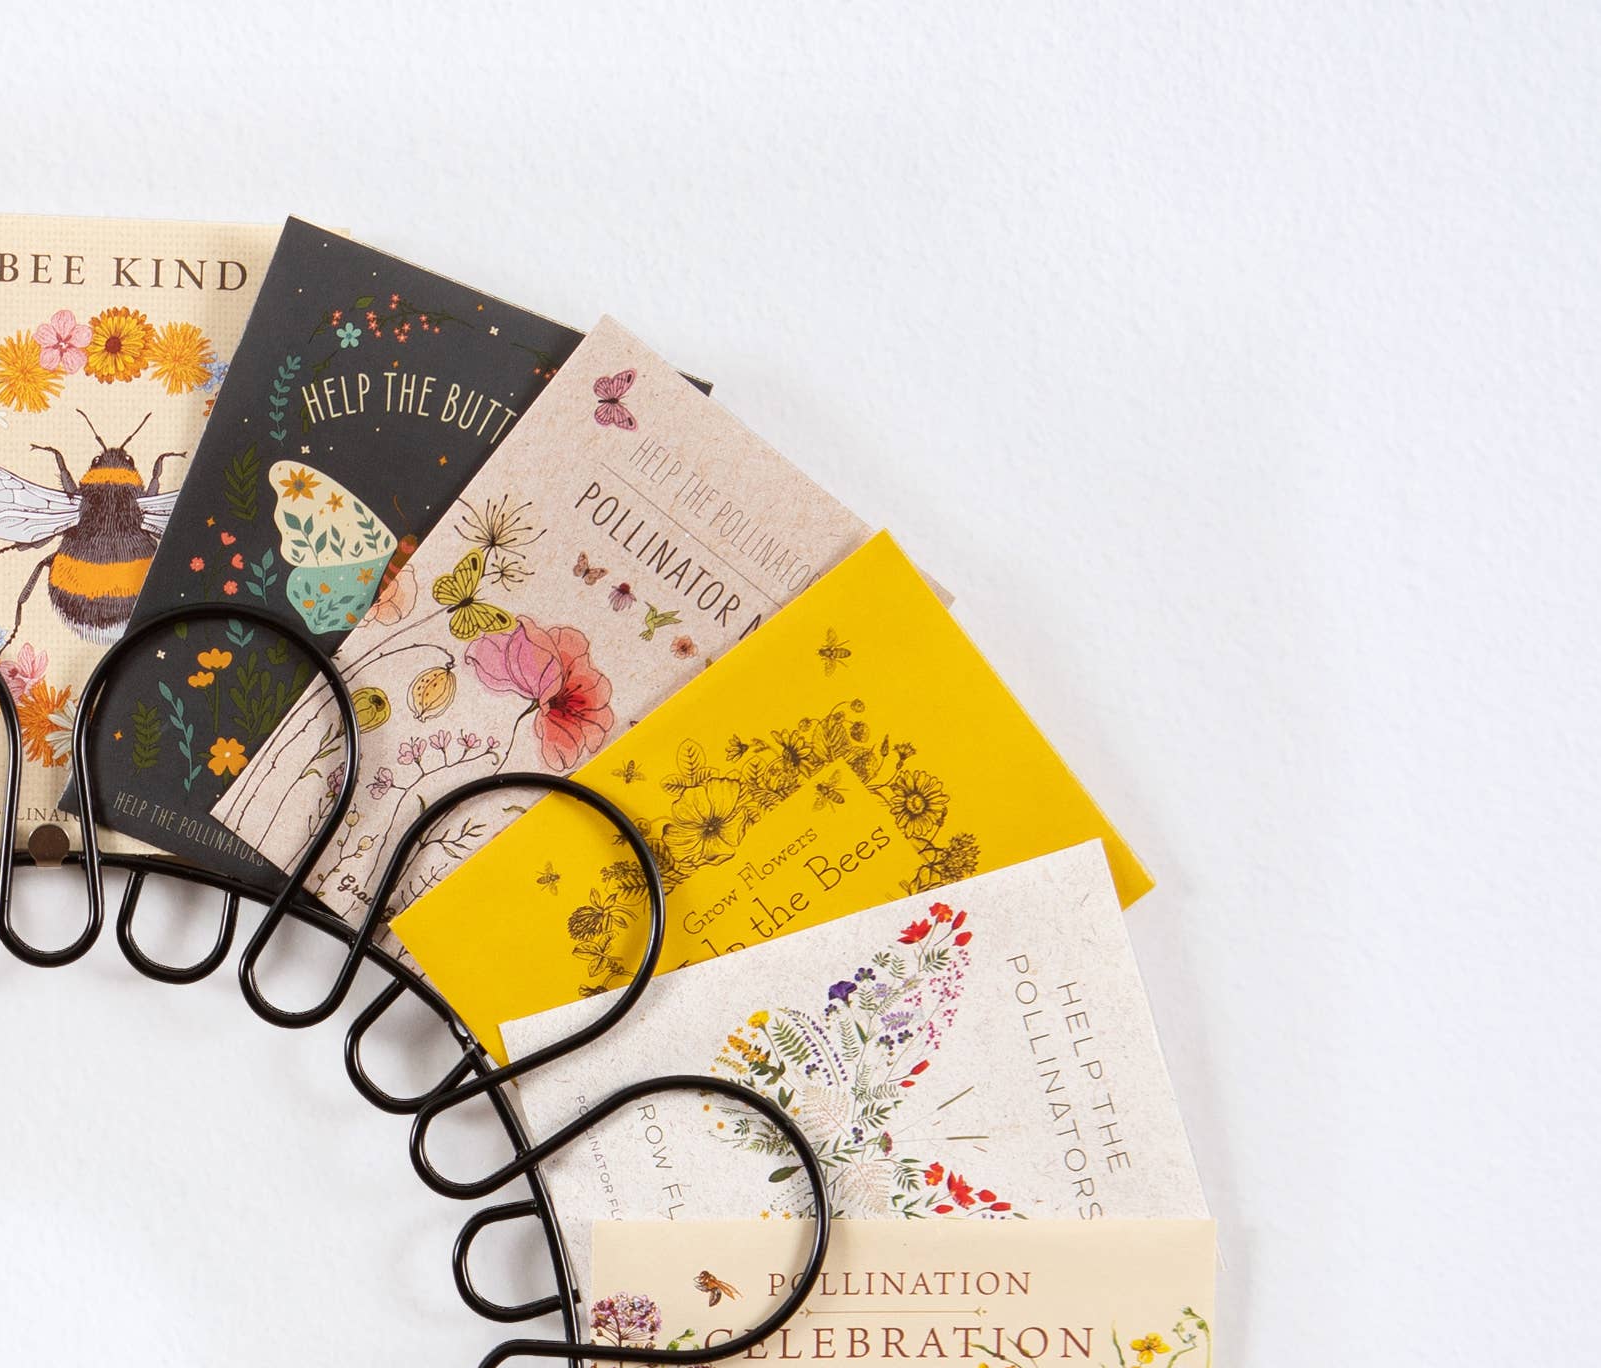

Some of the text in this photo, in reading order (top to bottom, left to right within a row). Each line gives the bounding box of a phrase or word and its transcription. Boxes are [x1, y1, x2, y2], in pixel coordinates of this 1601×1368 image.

[112, 257, 248, 291] KIND
[301, 373, 371, 424] HELP
[383, 372, 437, 417] THE
[629, 436, 682, 486] HELP
[675, 472, 720, 519] THE
[574, 481, 741, 628] POLLINATOR
[113, 792, 148, 819] HELP
[149, 804, 178, 831] THE
[683, 827, 818, 935] Grow Flowers
[749, 826, 891, 938] the Bees
[1056, 981, 1131, 1173] HELP THE
[576, 1095, 614, 1194] POINATOR
[637, 1104, 673, 1169] ROW
